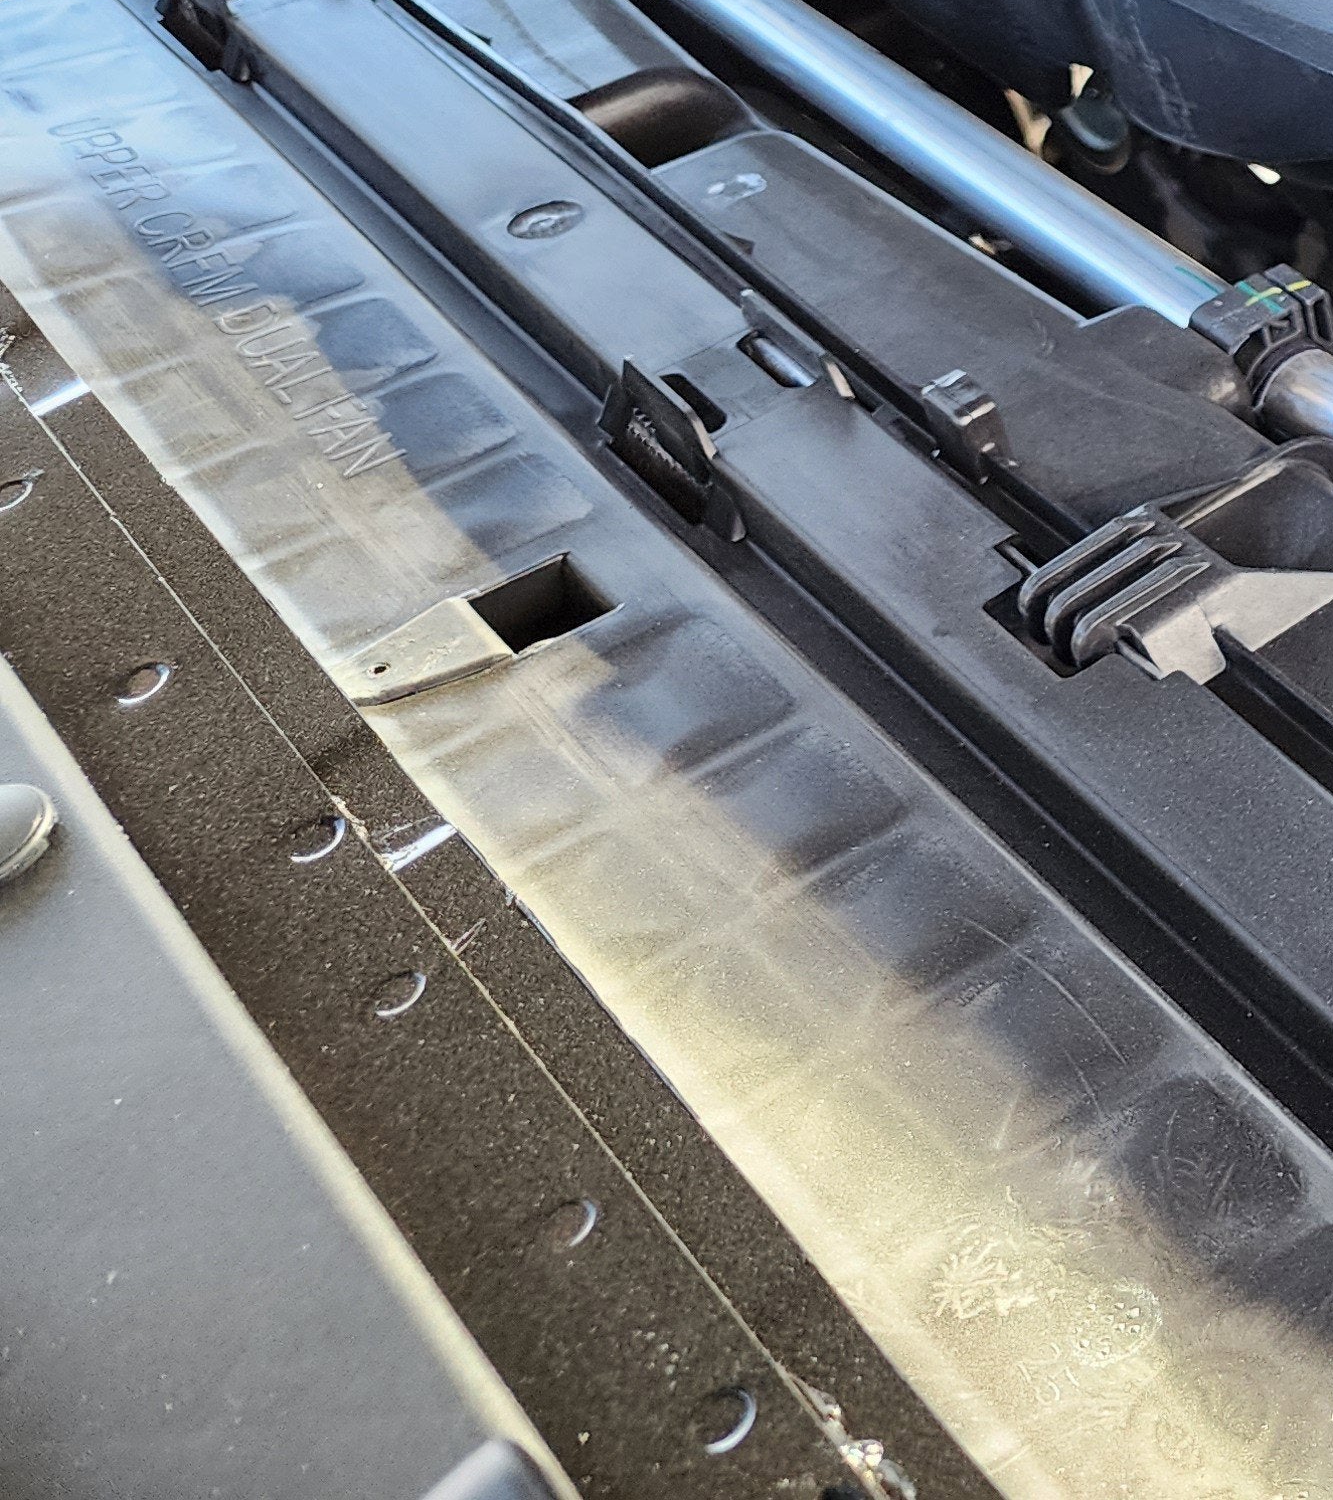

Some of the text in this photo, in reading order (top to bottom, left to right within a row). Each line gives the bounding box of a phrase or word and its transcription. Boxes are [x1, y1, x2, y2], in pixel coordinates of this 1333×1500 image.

[46, 117, 171, 210] UPPER
[212, 303, 333, 405] DUAL
[292, 392, 407, 479] FAN
